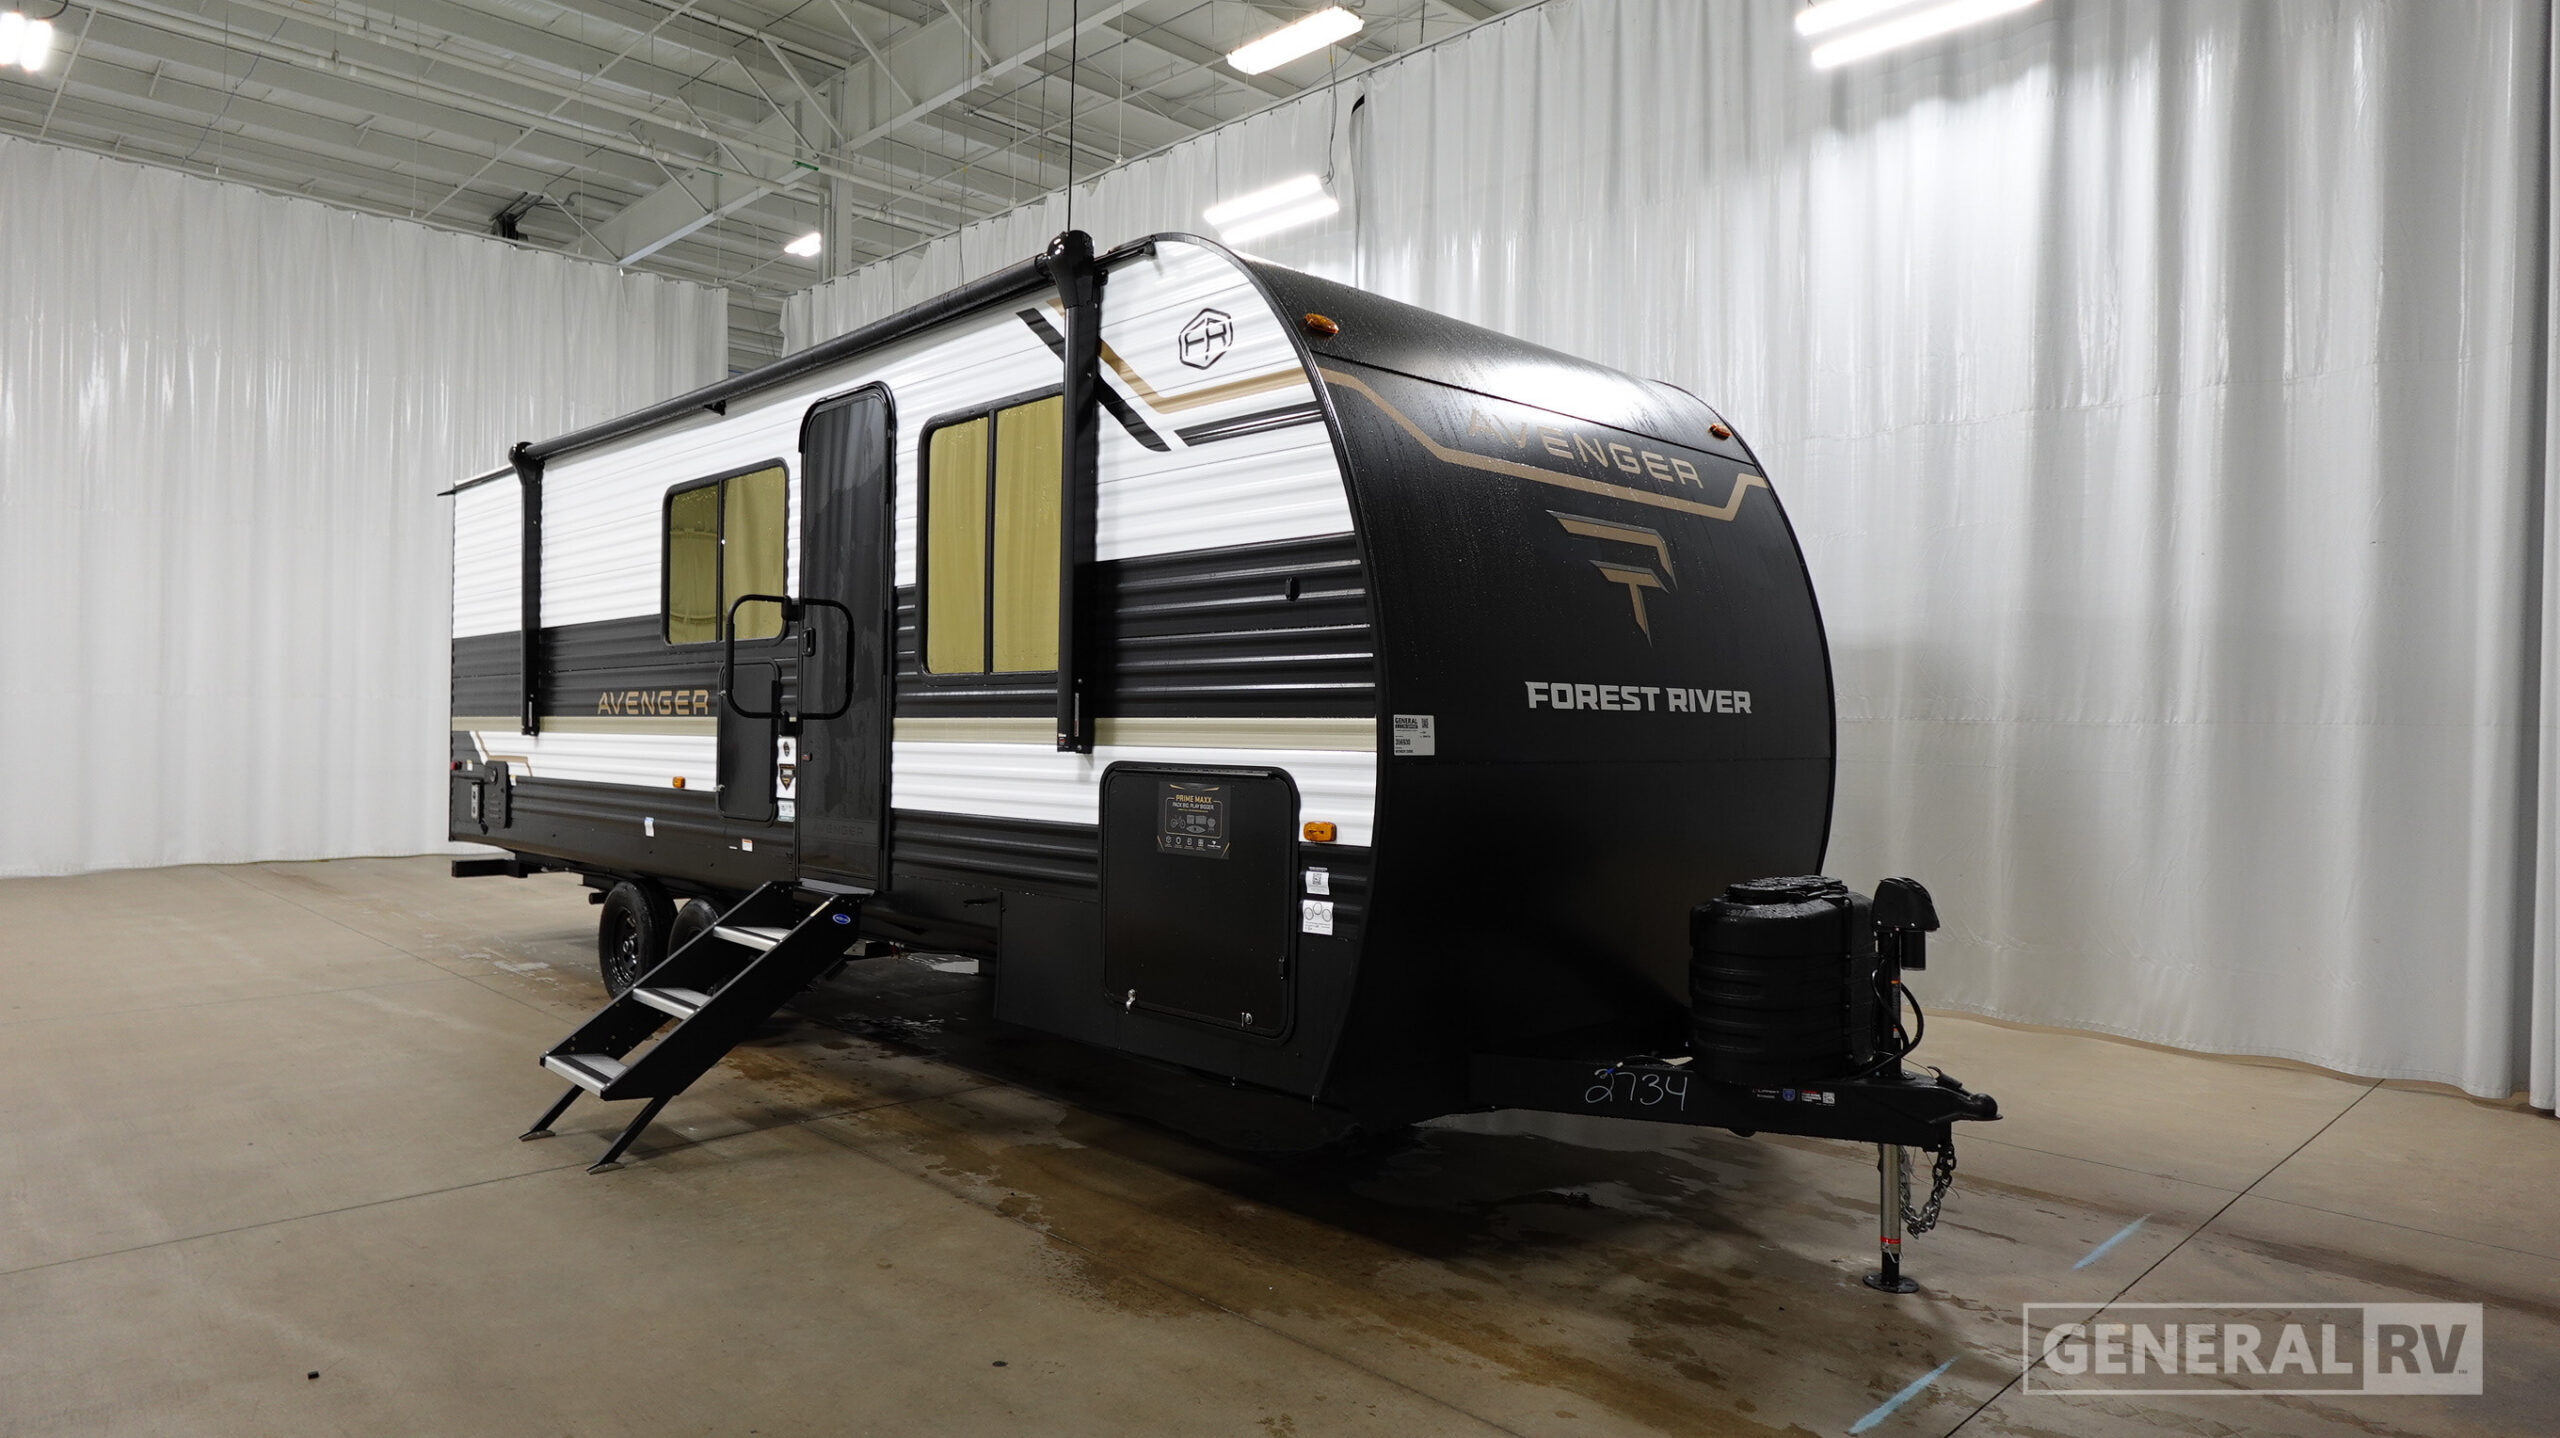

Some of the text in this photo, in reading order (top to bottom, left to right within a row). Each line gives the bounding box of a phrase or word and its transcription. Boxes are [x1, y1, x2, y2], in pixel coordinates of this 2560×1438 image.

[1468, 407, 1704, 489] AVENGER
[597, 689, 709, 715] AVENGER
[1525, 681, 1752, 714] FOREST RIVER
[1176, 795, 1212, 803] PRIME MAXX
[1585, 1068, 1689, 1112] 2734
